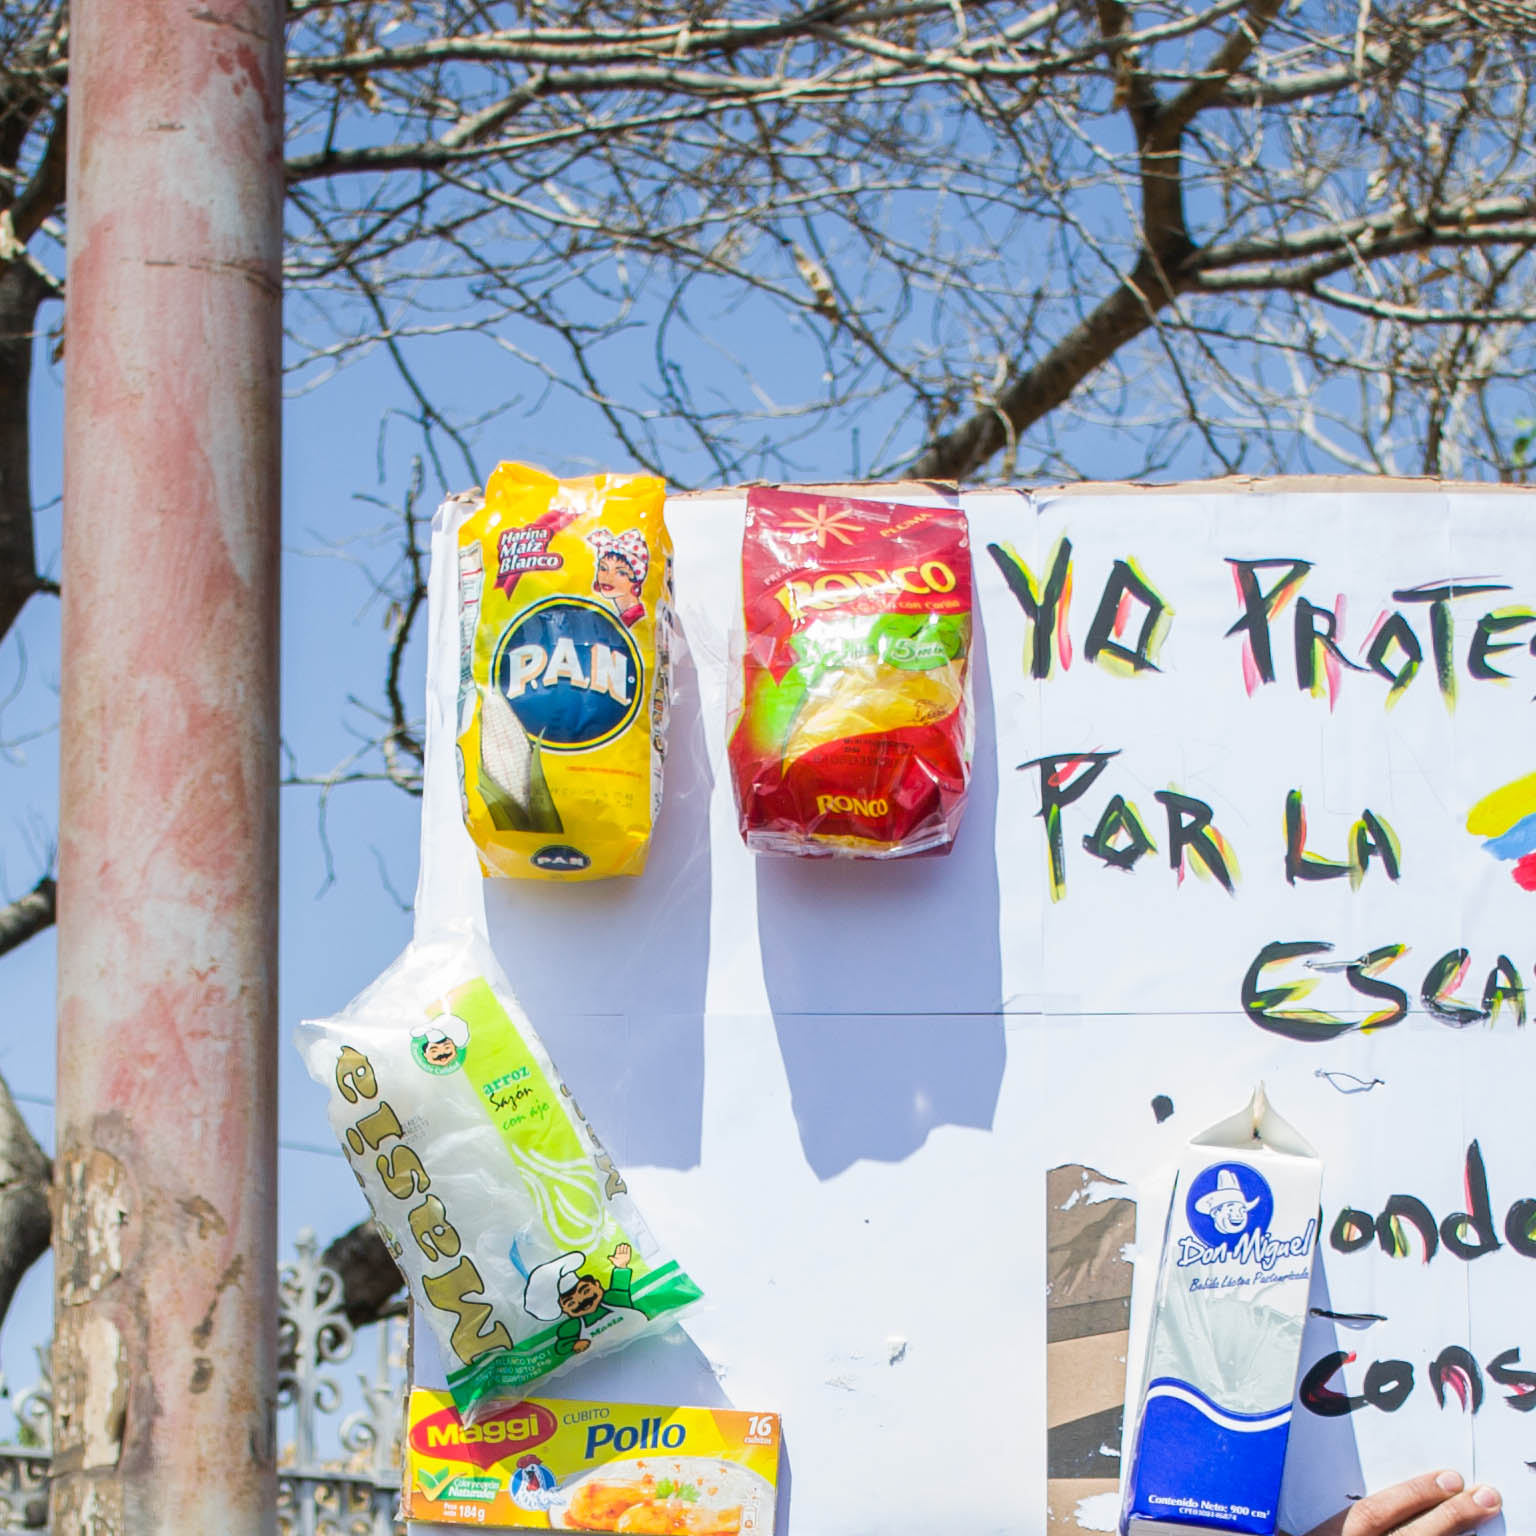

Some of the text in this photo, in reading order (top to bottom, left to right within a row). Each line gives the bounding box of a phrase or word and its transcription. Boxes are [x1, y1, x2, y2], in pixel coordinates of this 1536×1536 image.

[501, 528, 548, 546] Harina
[500, 554, 559, 574] Blanco
[986, 532, 1176, 682] YO
[816, 794, 889, 818] RONCO
[1282, 788, 1403, 892] LA
[483, 1065, 531, 1096] arroz
[1177, 1217, 1316, 1272] Don Miguel
[563, 1407, 610, 1425] CUBITO
[748, 1415, 773, 1437] 16
[426, 1413, 540, 1448] Maggi
[584, 1416, 687, 1460] Pollo
[459, 1505, 477, 1518] 184
[1148, 1494, 1199, 1508] Contenido
[1200, 1500, 1229, 1513] Neto:
[1230, 1504, 1250, 1516] 900
